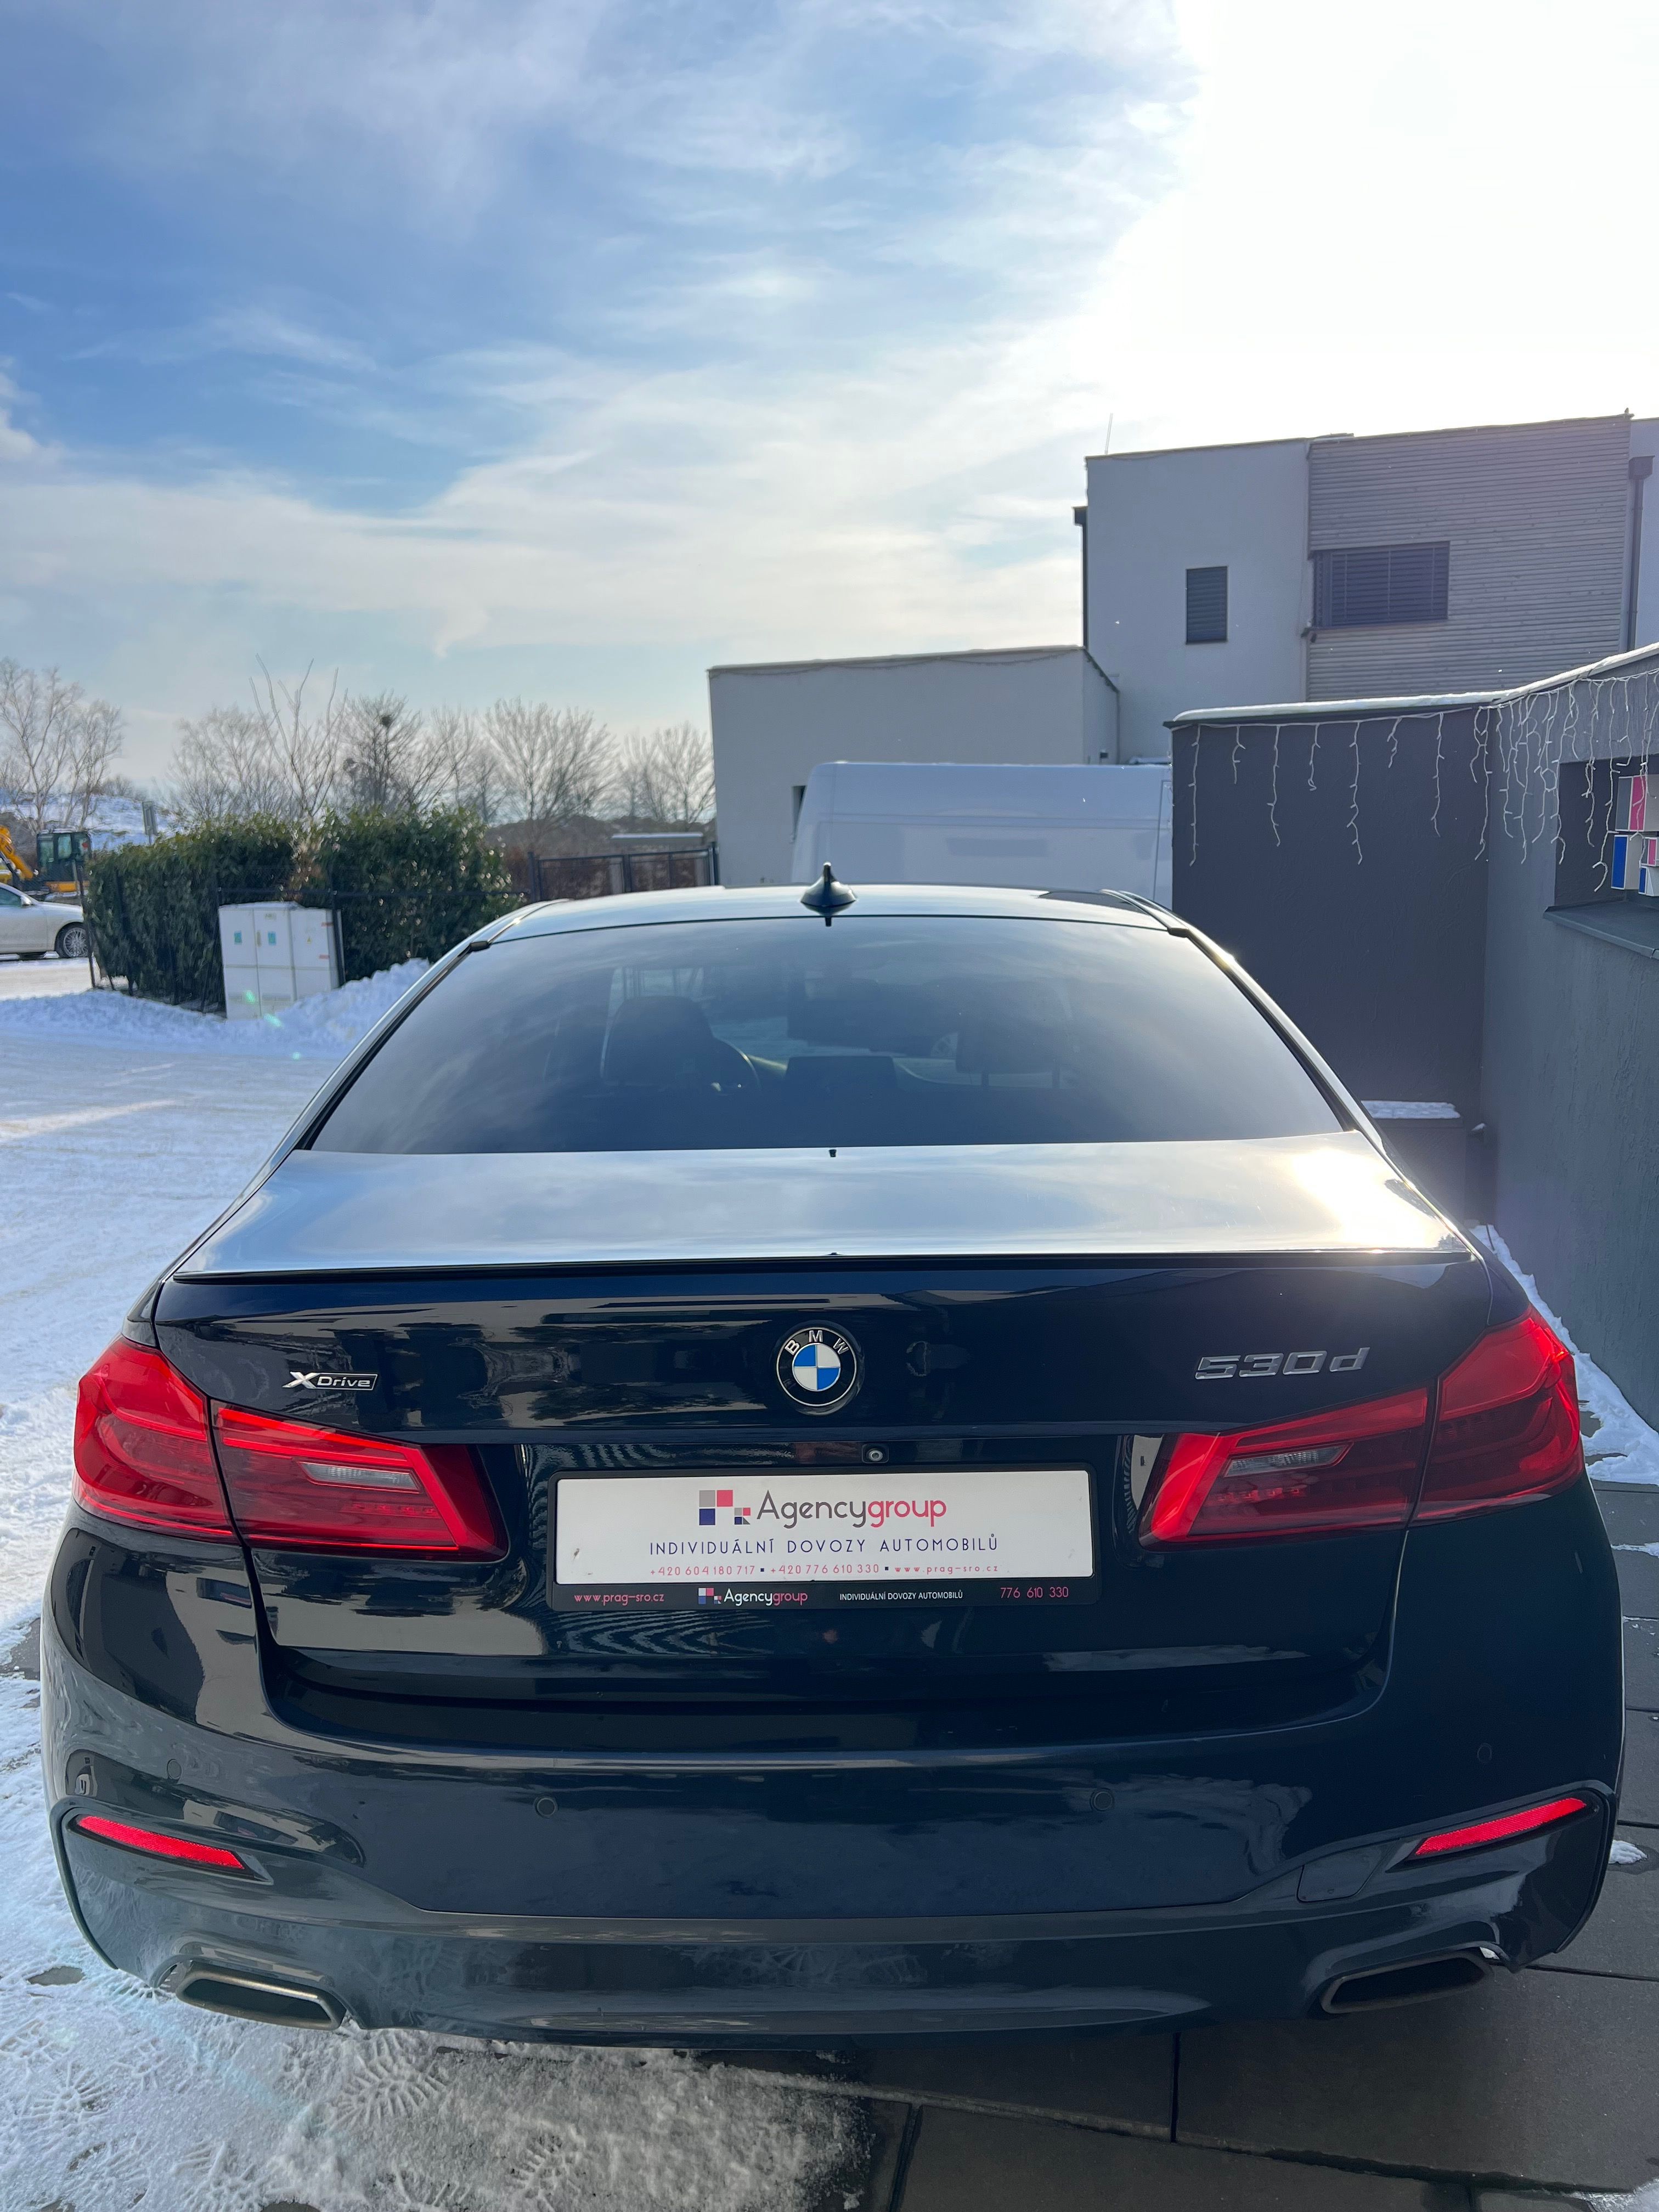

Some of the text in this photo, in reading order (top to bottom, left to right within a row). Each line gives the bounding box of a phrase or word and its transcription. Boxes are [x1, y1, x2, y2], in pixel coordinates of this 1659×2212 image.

[785, 1330, 849, 1356] BMW
[1195, 1347, 1370, 1380] 530d
[756, 1489, 947, 1528] Agencygroup
[650, 1533, 997, 1555] INDIVIDUÁLNÍ DOVOZY AUTOMOBILŮ
[650, 1564, 998, 1576] +420 604 180 717 +420 776 610 330 www.prag-sro.cz
[574, 1592, 665, 1606] www.prag-sro.cz
[723, 1588, 808, 1606] Agencygroup
[839, 1589, 963, 1601] INDIVIDUÁLNÍ DOVOZY AUTOMOBILŮ
[1000, 1586, 1069, 1599] 776 610 330
